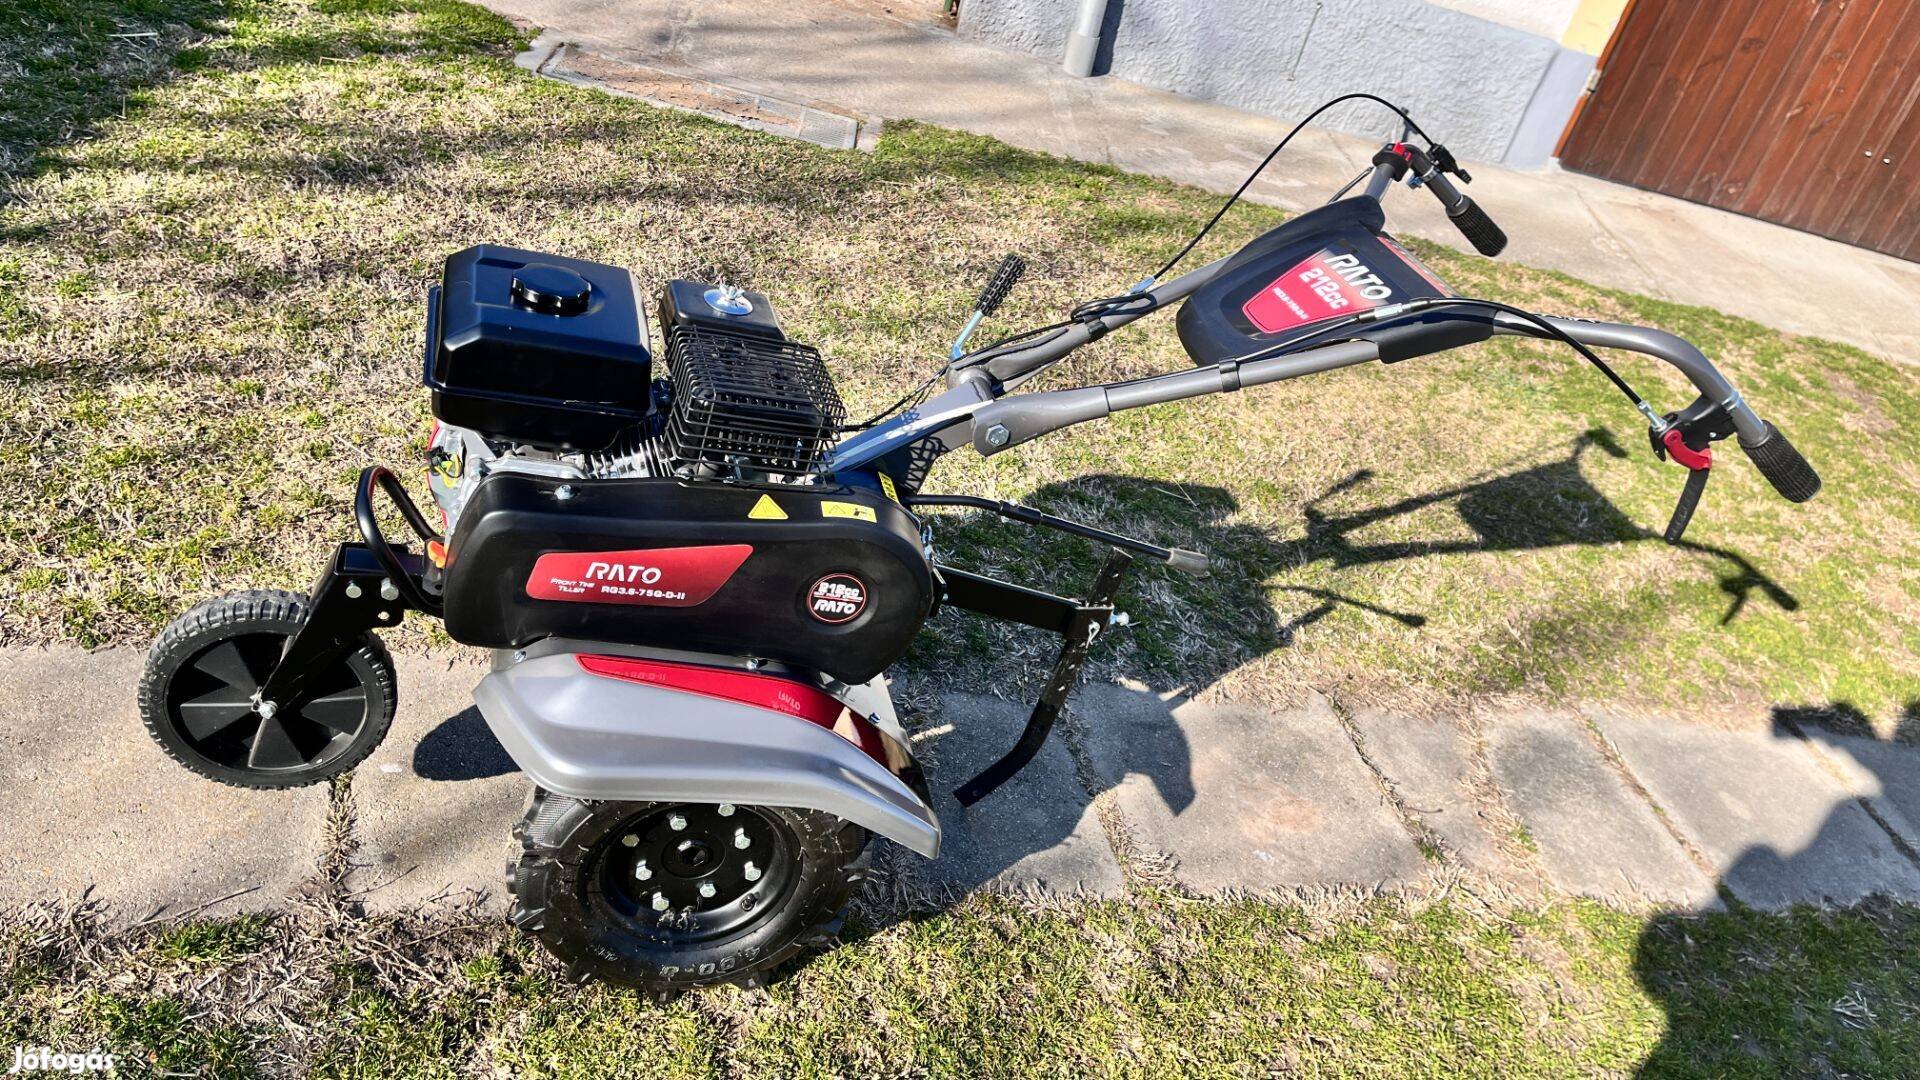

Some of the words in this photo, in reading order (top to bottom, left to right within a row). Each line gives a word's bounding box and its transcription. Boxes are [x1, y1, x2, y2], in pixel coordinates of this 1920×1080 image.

[1298, 267, 1349, 310] 212cc
[1323, 253, 1392, 300] RATO
[585, 561, 662, 584] RATO
[814, 599, 856, 614] RATO
